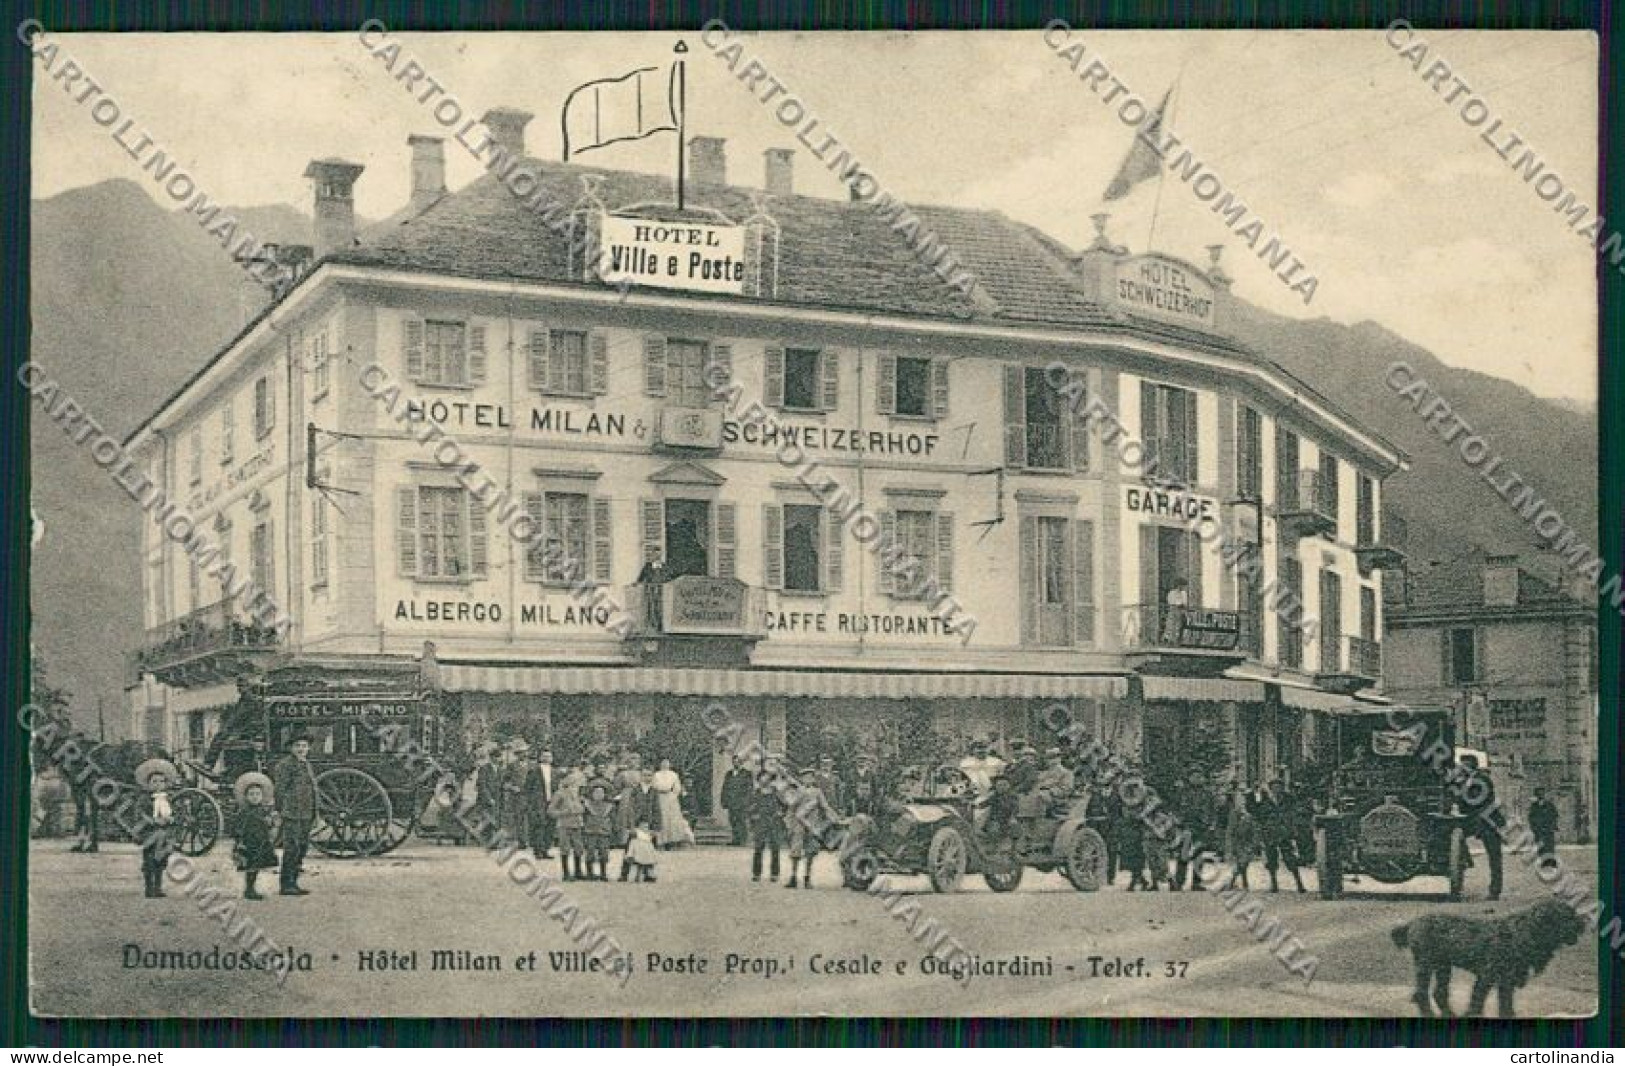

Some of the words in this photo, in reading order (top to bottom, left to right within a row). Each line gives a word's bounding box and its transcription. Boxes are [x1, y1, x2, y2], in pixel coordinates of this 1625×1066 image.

[634, 225, 719, 247] HOTEL
[611, 245, 657, 275] Ville
[666, 255, 678, 276] e
[688, 251, 743, 282] Poste
[1140, 262, 1191, 292] HOTEL
[1119, 278, 1213, 318] SCHWEIZERHOF
[408, 399, 511, 428] HOTEL
[531, 408, 624, 435] MILAN
[633, 418, 647, 438] &
[722, 421, 939, 456] SCHWEIZERHOF
[1127, 488, 1213, 521] GARAGE
[395, 600, 501, 622] ALBERGO
[521, 604, 609, 625] MILANO
[764, 610, 827, 632] CAFFE
[838, 613, 954, 635] RISTORANTE
[276, 704, 334, 716] HOTEL
